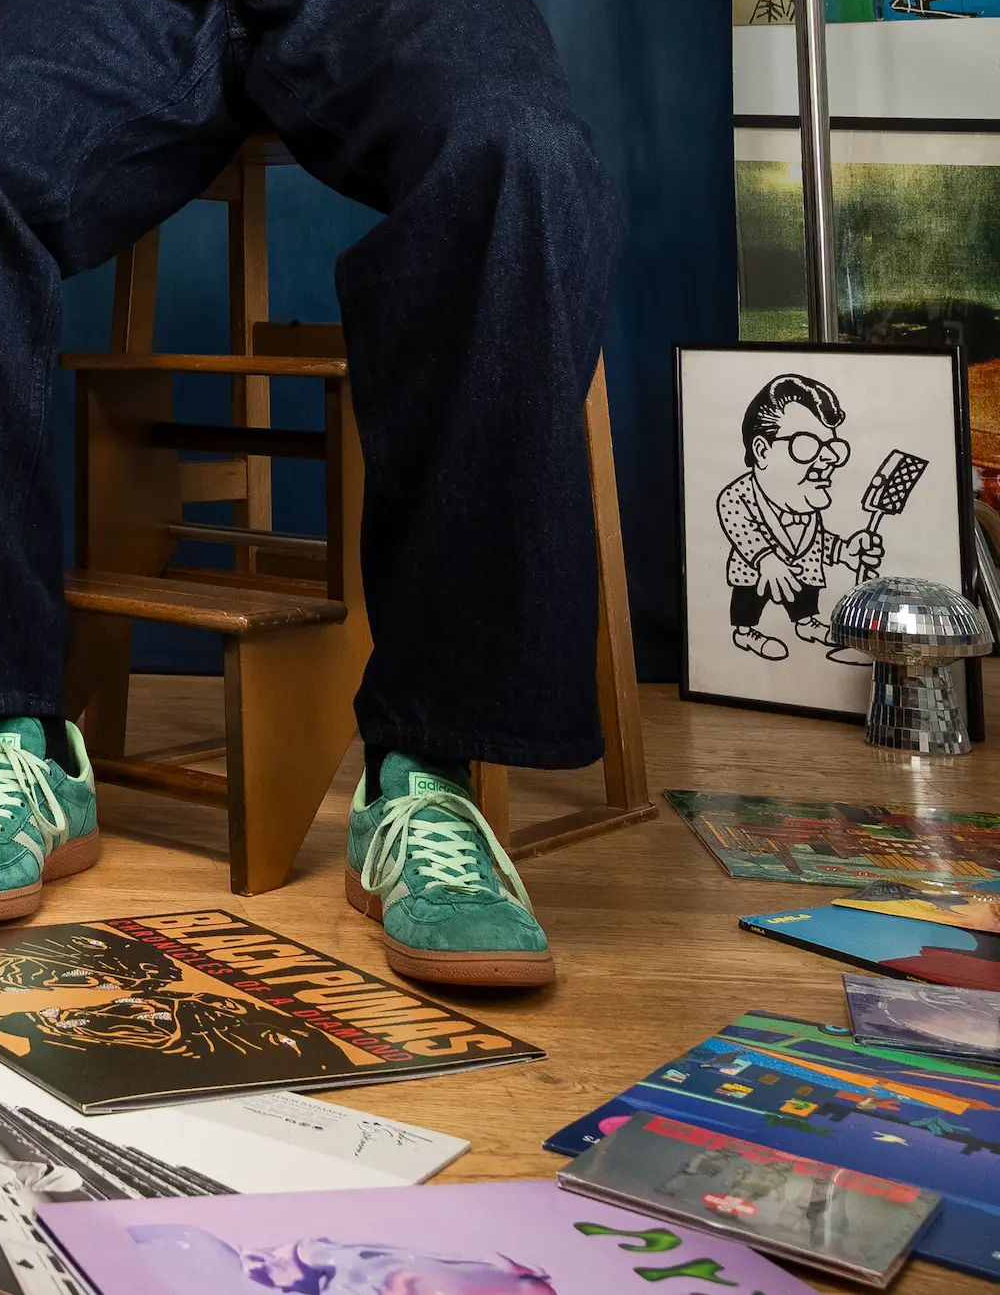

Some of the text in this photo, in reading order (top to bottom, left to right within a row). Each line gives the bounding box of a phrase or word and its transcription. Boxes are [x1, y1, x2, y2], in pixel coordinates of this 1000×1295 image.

[108, 917, 414, 1063] CHRONICLES OF A DIAMOND
[133, 912, 513, 1058] BLACK PUMAS
